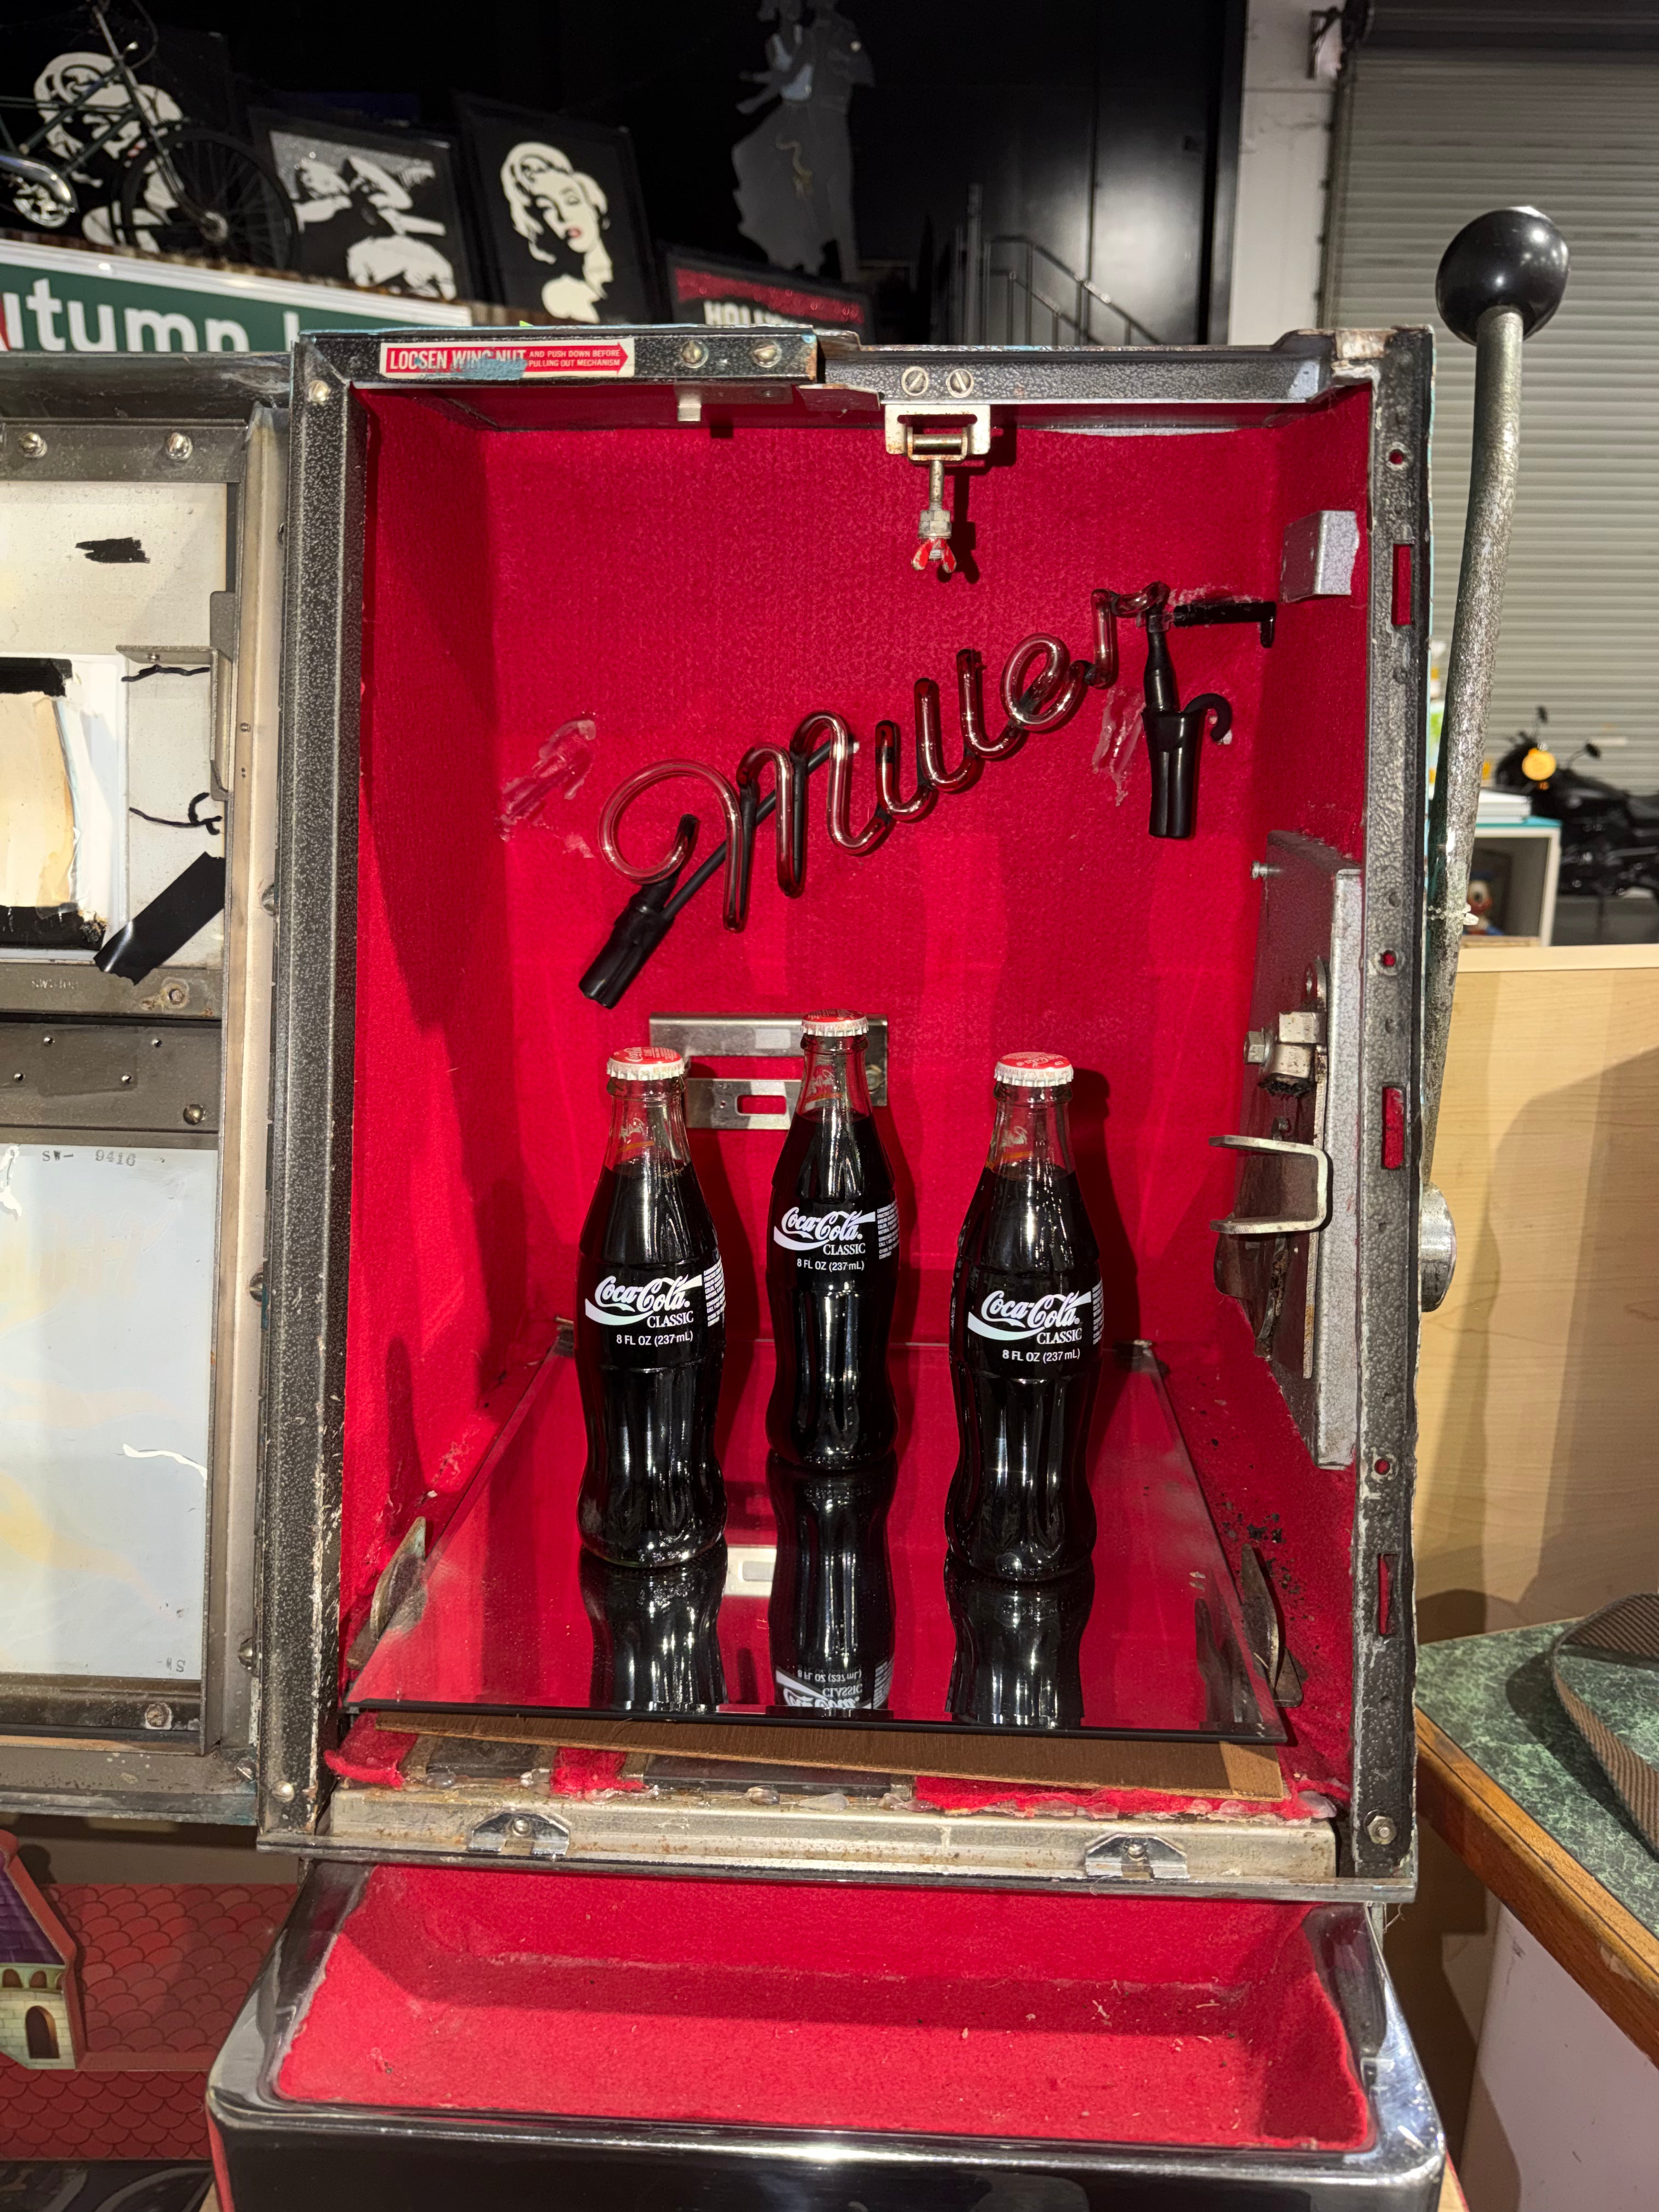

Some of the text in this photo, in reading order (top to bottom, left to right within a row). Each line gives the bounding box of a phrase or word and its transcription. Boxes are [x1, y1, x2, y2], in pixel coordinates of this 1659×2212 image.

[95, 1149, 137, 1166] 9416
[823, 1243, 866, 1255] CLASSIC
[797, 1258, 802, 1267] 8
[804, 1259, 814, 1269] FL
[815, 1261, 827, 1270] OZ
[647, 1311, 694, 1328] CLASSIC
[616, 1334, 622, 1344] 8
[624, 1335, 636, 1345] FL
[638, 1335, 652, 1346] OZ
[1036, 1328, 1082, 1344] CLASSIC
[1002, 1348, 1080, 1364] 8 FL OZ (237 mL)
